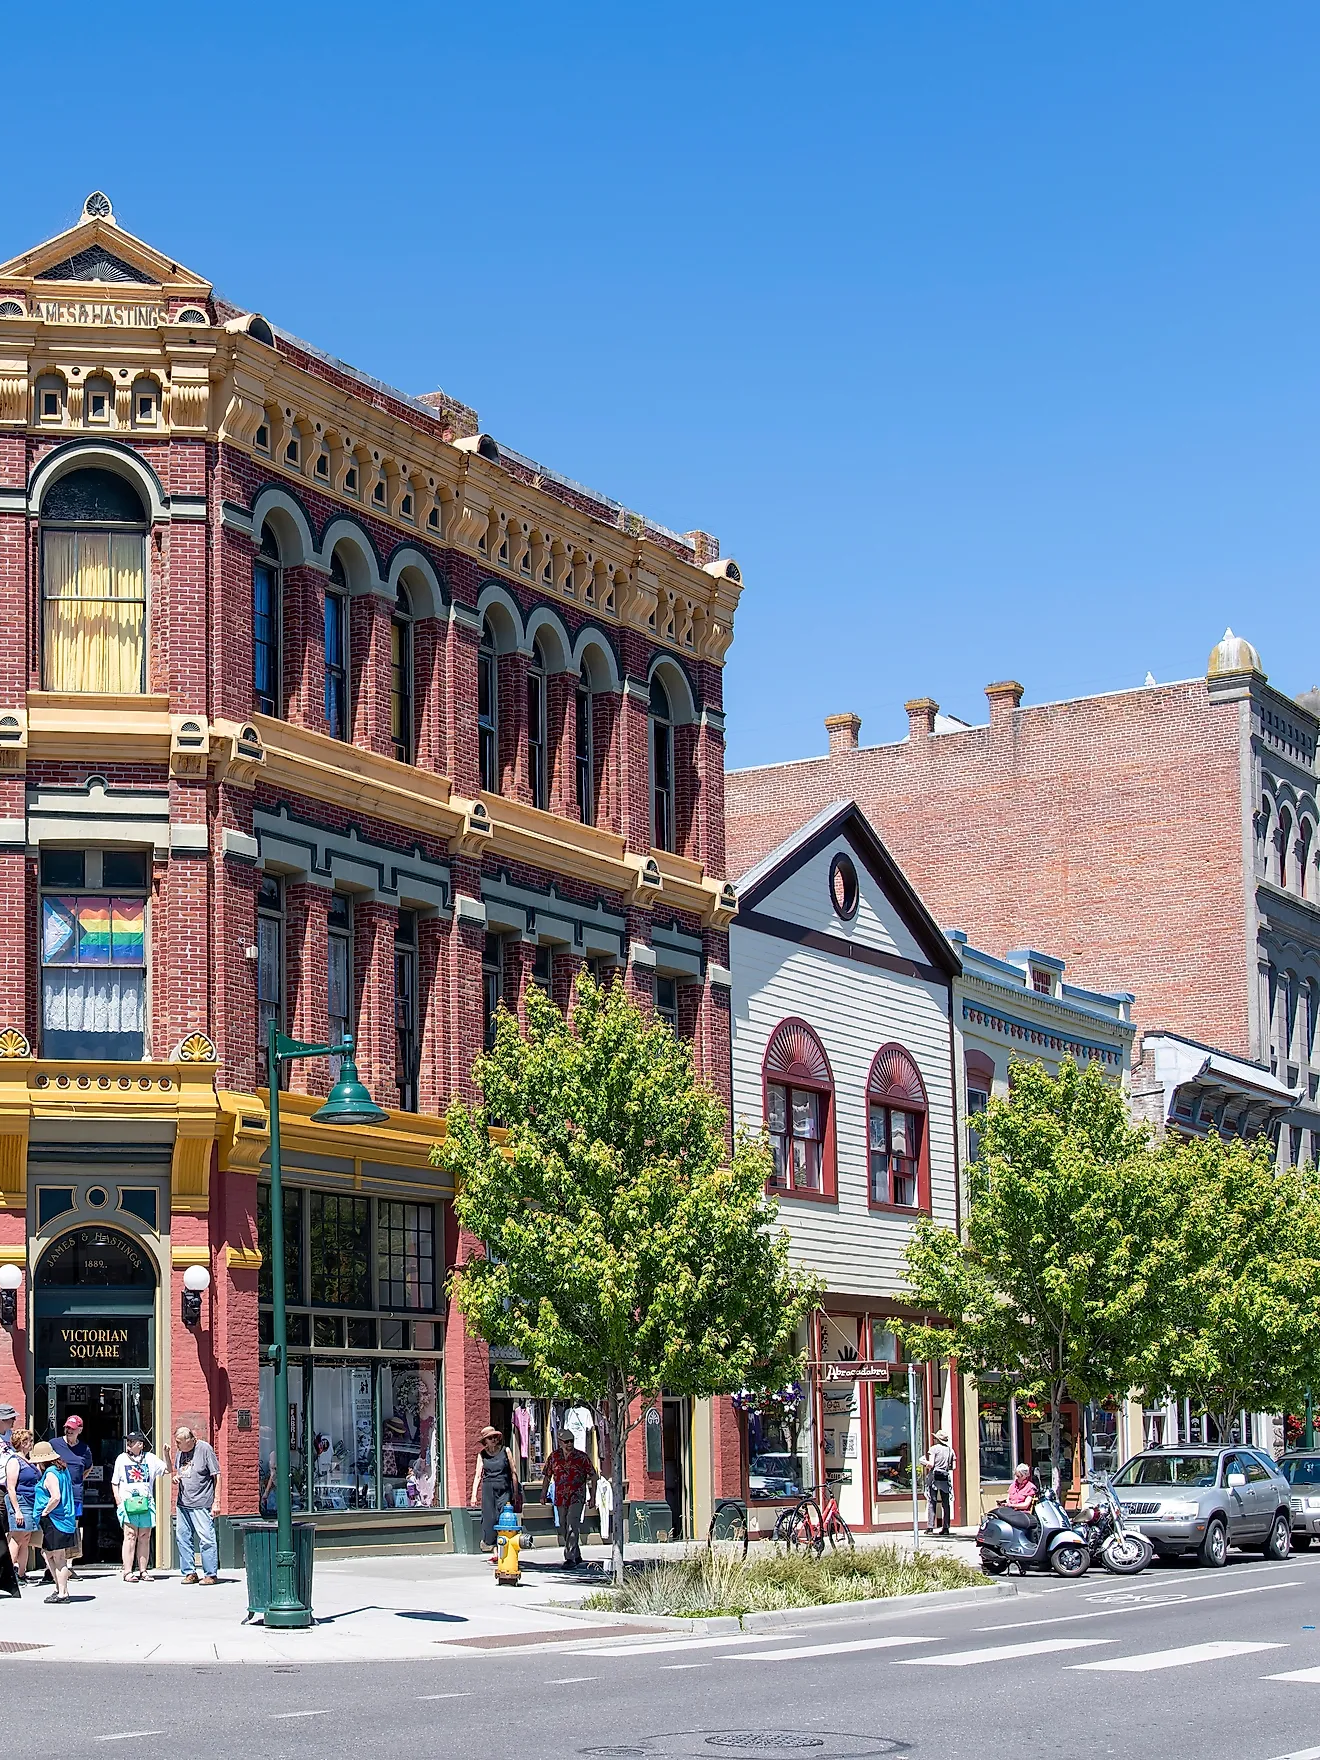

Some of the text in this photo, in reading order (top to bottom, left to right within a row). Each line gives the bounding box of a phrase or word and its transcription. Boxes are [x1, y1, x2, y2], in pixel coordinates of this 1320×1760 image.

[91, 304, 167, 326] HASTINGS
[46, 1232, 142, 1268] JAMES & HASTINGS
[84, 1259, 104, 1268] 1889
[61, 1329, 128, 1342] VICTORIAN
[69, 1344, 120, 1358] SQUARE
[826, 1364, 887, 1380] Abracadabra
